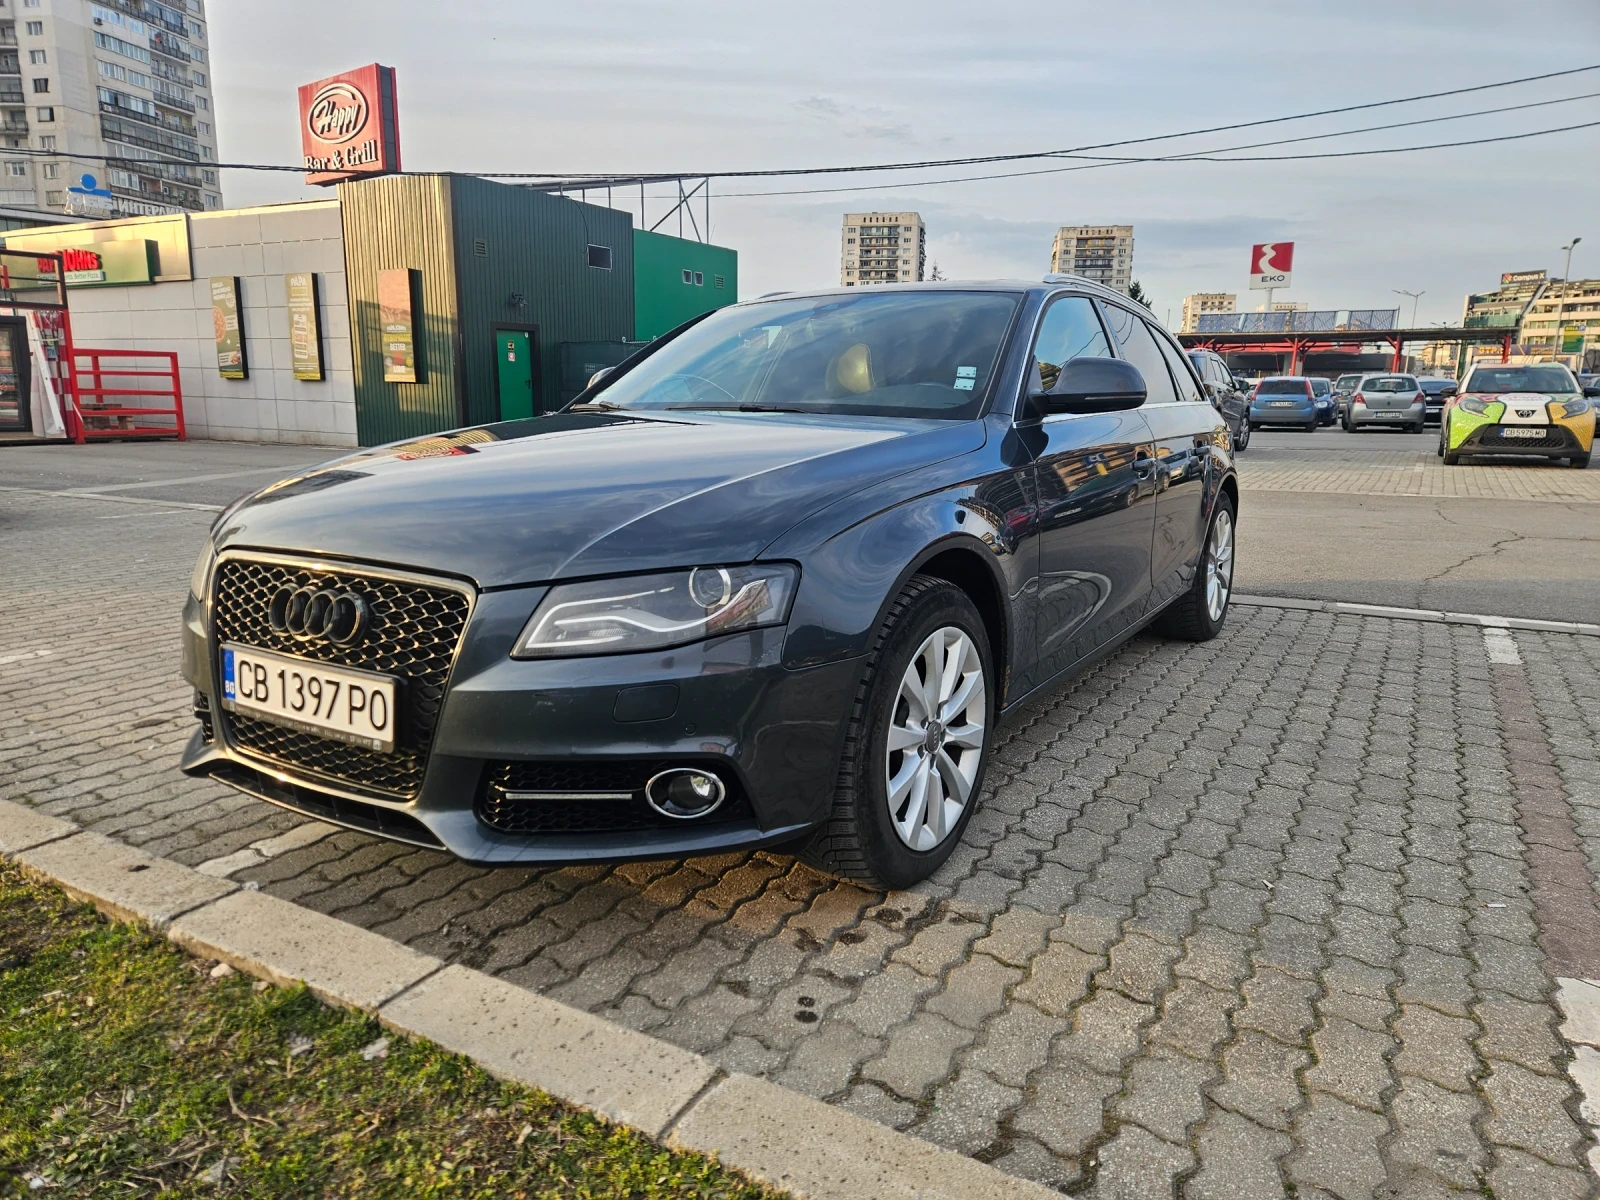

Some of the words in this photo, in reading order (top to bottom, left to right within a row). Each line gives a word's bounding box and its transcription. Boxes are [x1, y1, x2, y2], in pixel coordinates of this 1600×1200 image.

[313, 100, 361, 135] Happy
[304, 156, 330, 175] Bar
[331, 150, 344, 170] &
[345, 140, 378, 166] Grill
[290, 276, 307, 286] PAPA
[1513, 274, 1539, 282] Campus
[225, 680, 235, 695] BG
[239, 660, 269, 703] CB
[277, 668, 340, 720] 1397
[347, 683, 387, 731] PO
